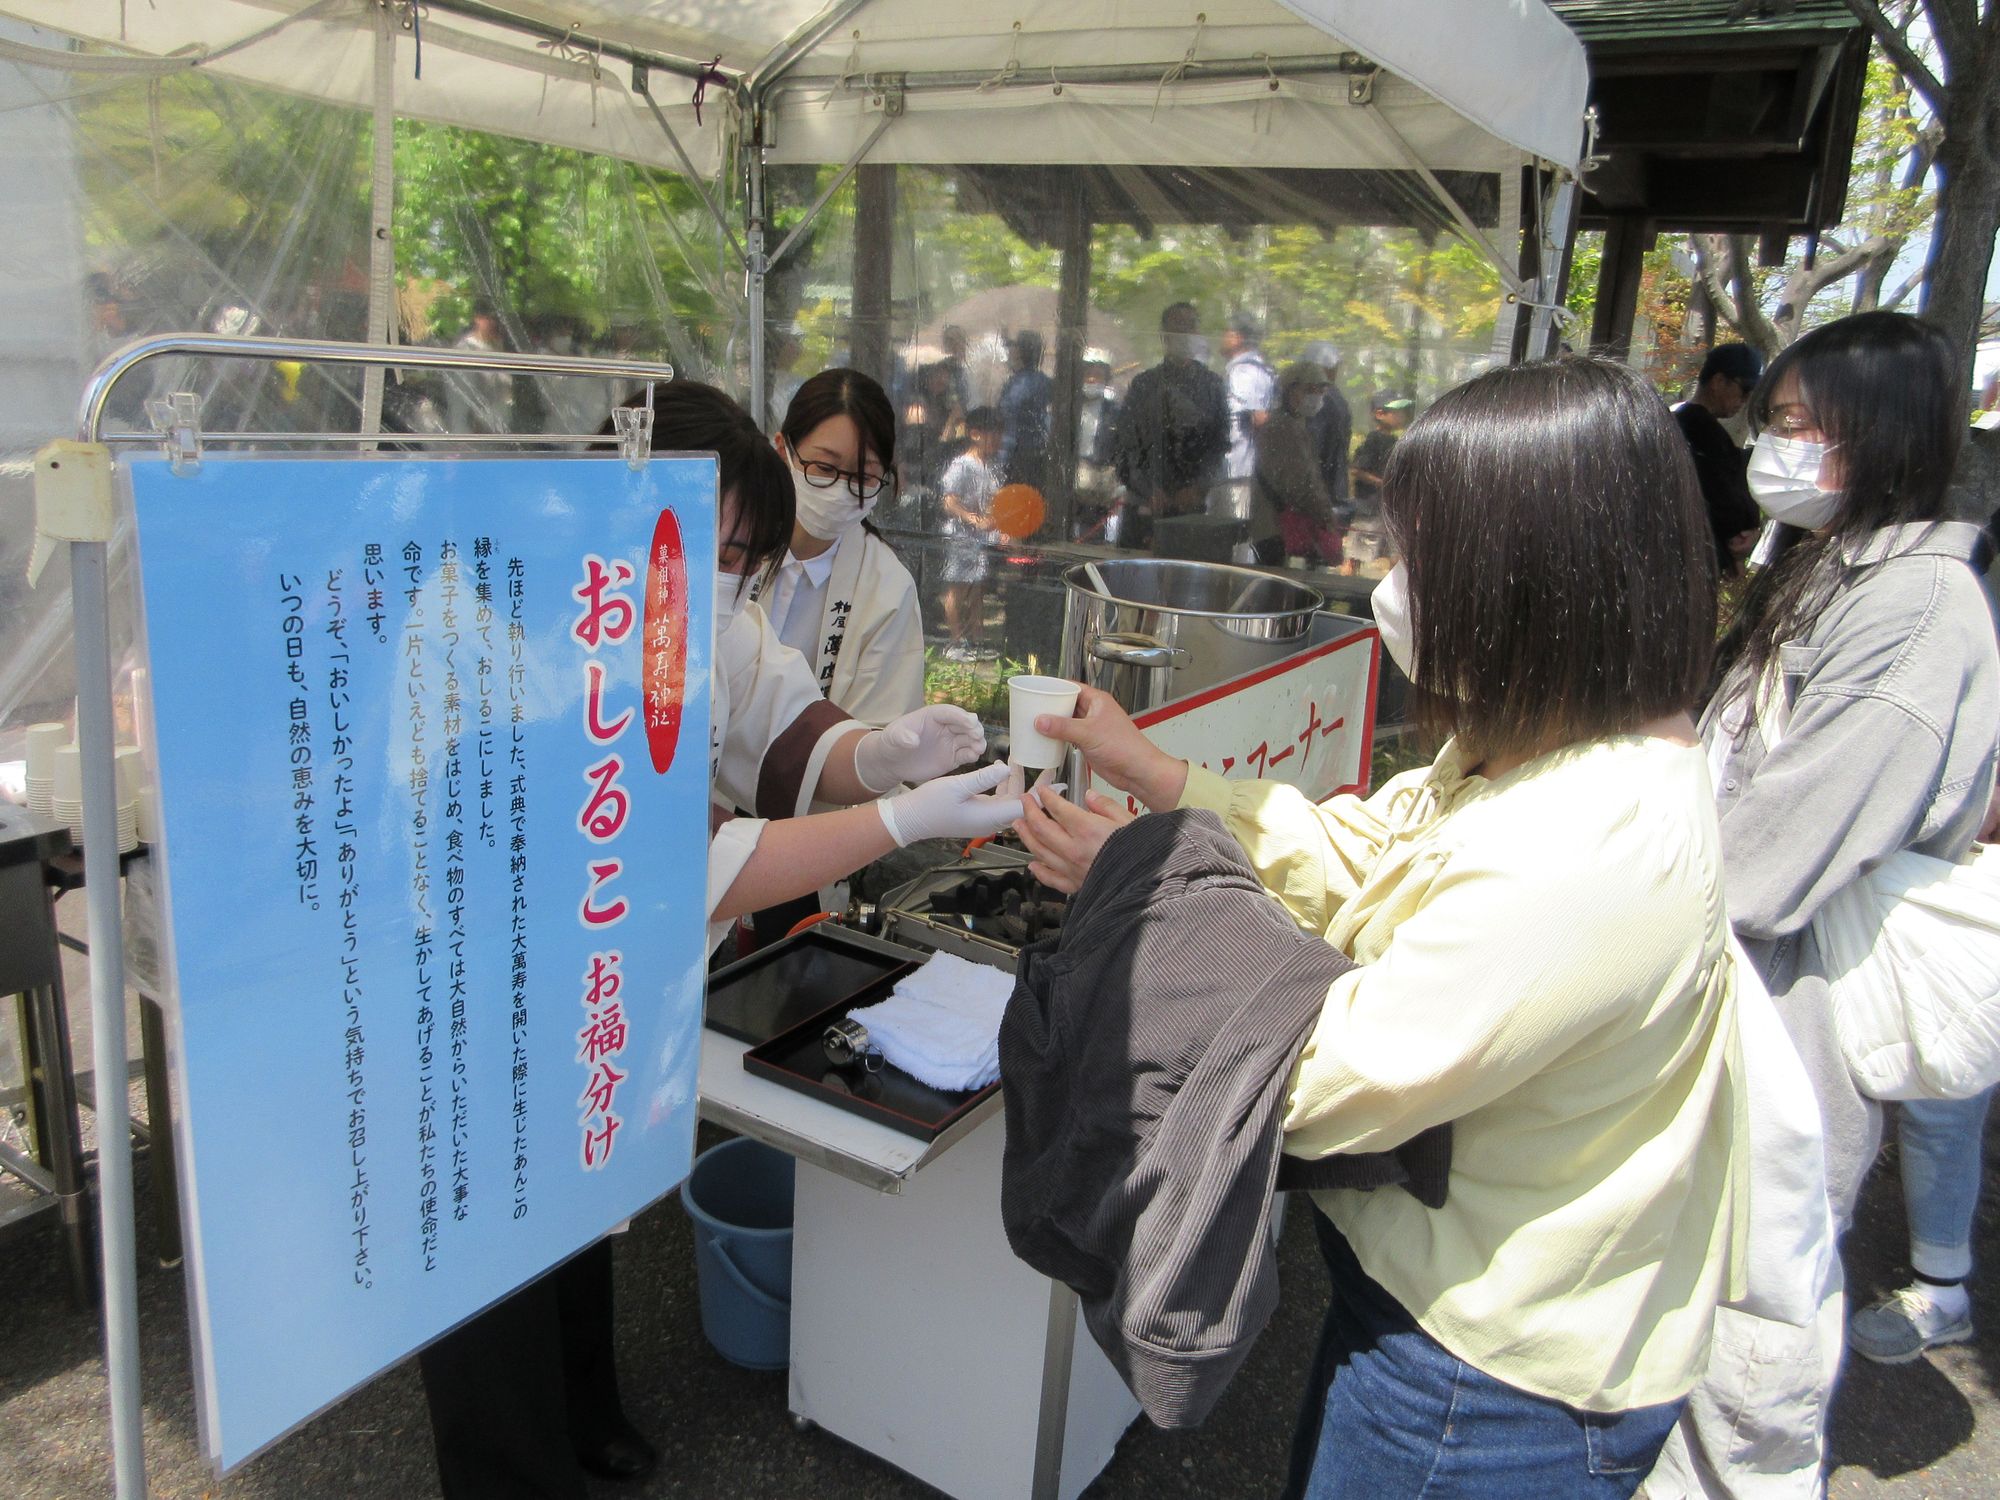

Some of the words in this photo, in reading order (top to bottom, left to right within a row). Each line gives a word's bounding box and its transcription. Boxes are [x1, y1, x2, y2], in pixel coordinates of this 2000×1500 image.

[280, 573, 320, 912] いつの日も、自然の恵みを大切に。
[363, 543, 388, 645] 思います。
[473, 537, 496, 848] 縁を集めて、おしるこにしました。
[575, 556, 634, 927] おしるこ
[402, 540, 439, 1273] 命です。一片といえども捨てることなく、生かしてあげることが私たちの使命だと
[440, 540, 470, 1222] お菓子をつくる素材をはじめ、食べ物のすべては大自然からいただいた大事な
[578, 954, 626, 1169] お福分け
